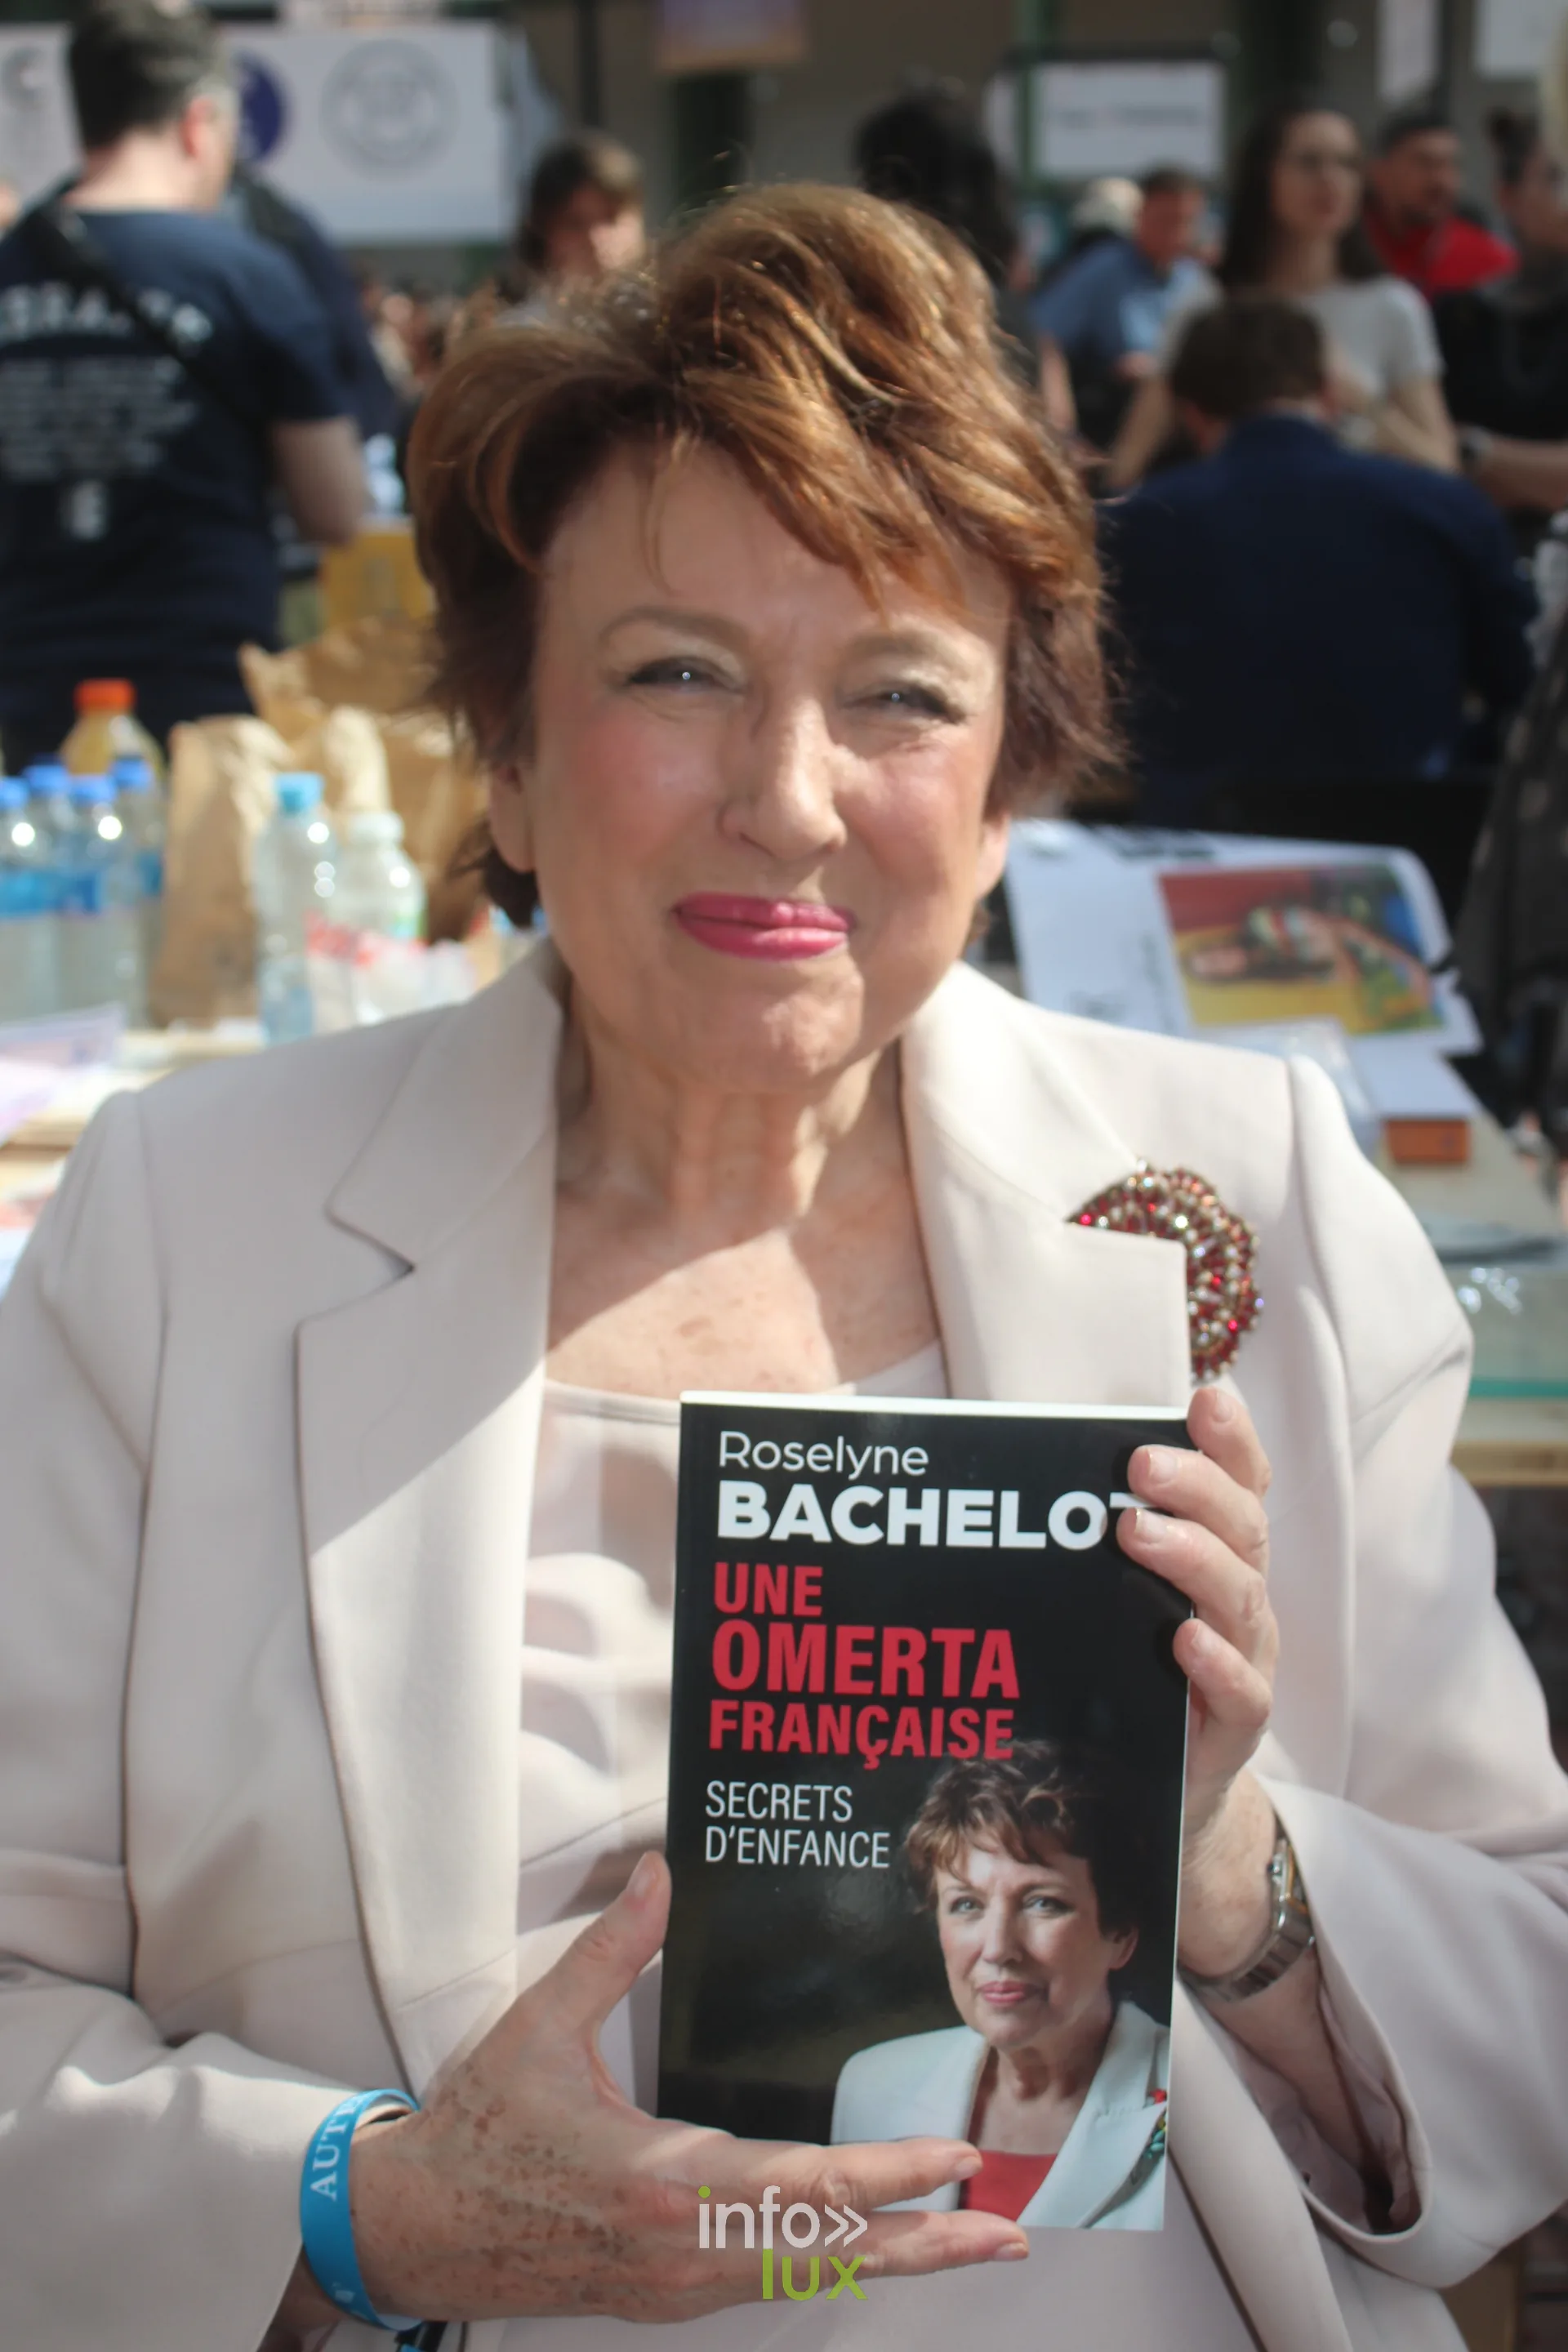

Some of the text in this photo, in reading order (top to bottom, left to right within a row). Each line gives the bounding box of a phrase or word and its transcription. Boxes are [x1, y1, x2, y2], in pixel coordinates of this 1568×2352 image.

[719, 1430, 929, 1480] Roselyne
[717, 1480, 1160, 1551] BACHELO
[713, 1561, 824, 1617] UNE
[712, 1619, 1020, 1699] OMERTA
[709, 1699, 1015, 1771] FRANÇAISE
[705, 1780, 853, 1823] SECRETS
[705, 1827, 891, 1869] D'ENFANCE
